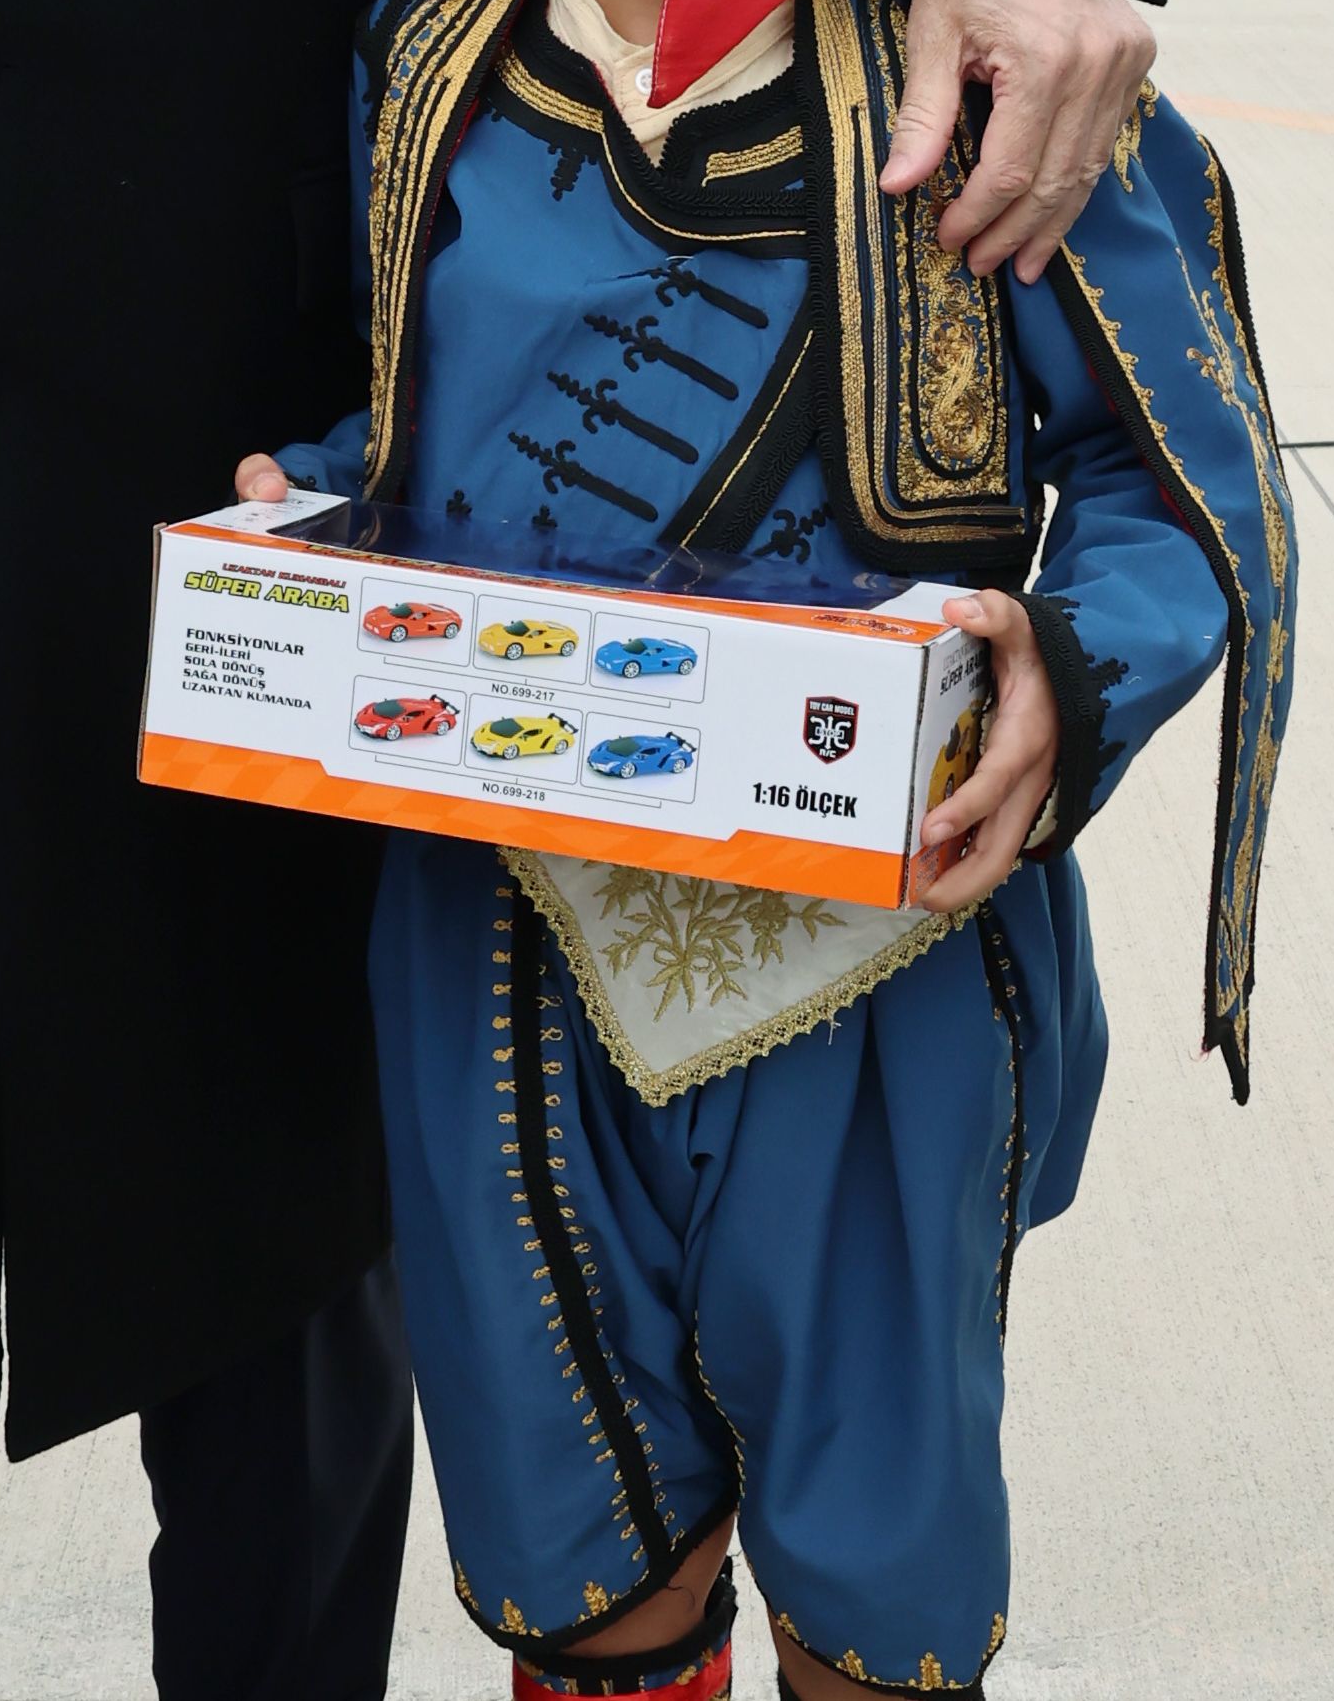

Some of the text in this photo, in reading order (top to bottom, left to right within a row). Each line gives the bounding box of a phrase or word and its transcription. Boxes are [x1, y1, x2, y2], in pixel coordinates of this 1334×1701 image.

[184, 570, 350, 613] SÜPER ARABA
[185, 642, 251, 660] GERİ-İLERİ
[186, 628, 304, 656] FONKSİYONLAR
[184, 655, 265, 678] SOLA DÖNÜŞ
[183, 668, 266, 691] SAĞA DÖNÜŞ
[182, 681, 312, 710] UZAKTAN KUMANDA
[491, 683, 555, 702] NO.699-217
[482, 782, 546, 801] NO.699-218
[753, 782, 858, 819] 1:16 ÖLÇEK
